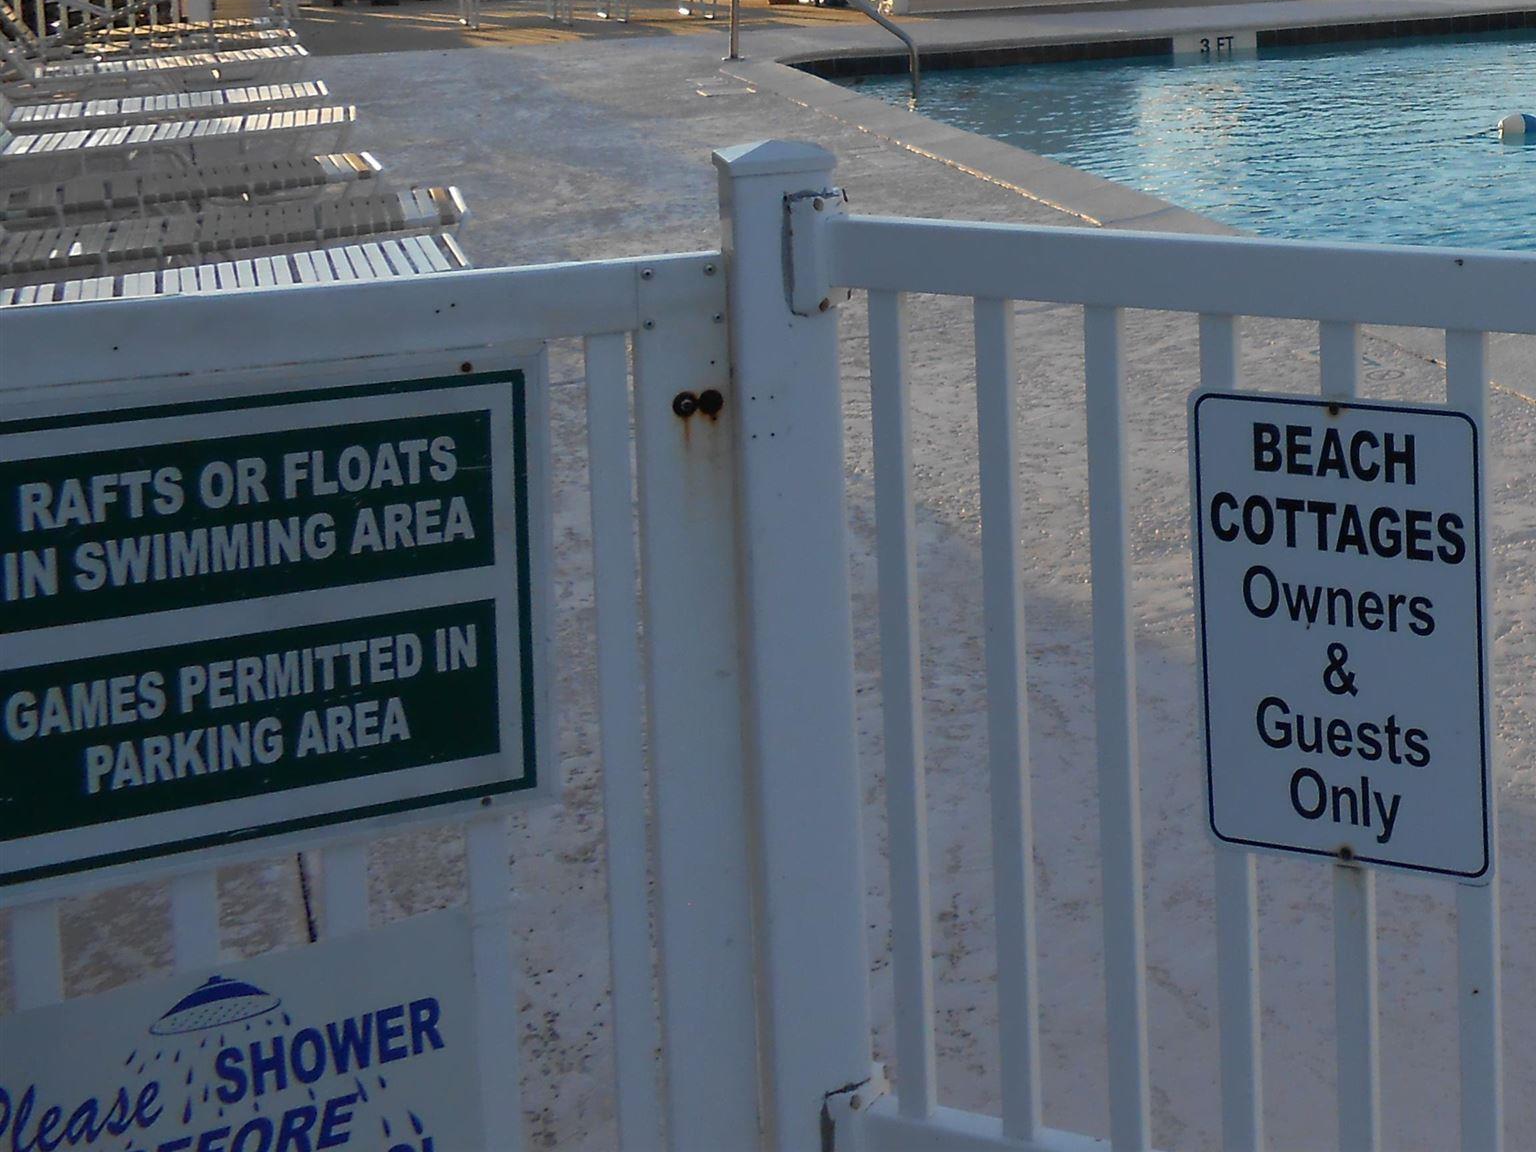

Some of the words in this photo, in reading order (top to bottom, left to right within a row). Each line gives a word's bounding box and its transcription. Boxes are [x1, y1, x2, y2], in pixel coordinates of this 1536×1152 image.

[1200, 38, 1210, 53] 3
[1216, 36, 1234, 55] FT
[20, 467, 184, 532] RAFTS
[200, 457, 269, 508] OR
[283, 436, 458, 500] FLOATS
[1252, 421, 1416, 485] BEACH
[4, 548, 59, 601] IN
[75, 512, 336, 591] SWIMMING
[350, 496, 476, 555] AREA
[1210, 492, 1466, 565] COTTAGES
[1242, 565, 1436, 636] Owners
[5, 671, 166, 742] GAMES
[180, 633, 424, 714] PERMITTED
[435, 623, 478, 673] IN
[1322, 642, 1358, 697] &
[86, 717, 283, 794] PARKING
[297, 696, 411, 758] AREA
[1256, 696, 1431, 768] Guests
[1289, 767, 1402, 844] Only
[215, 996, 445, 1104] SHOWER
